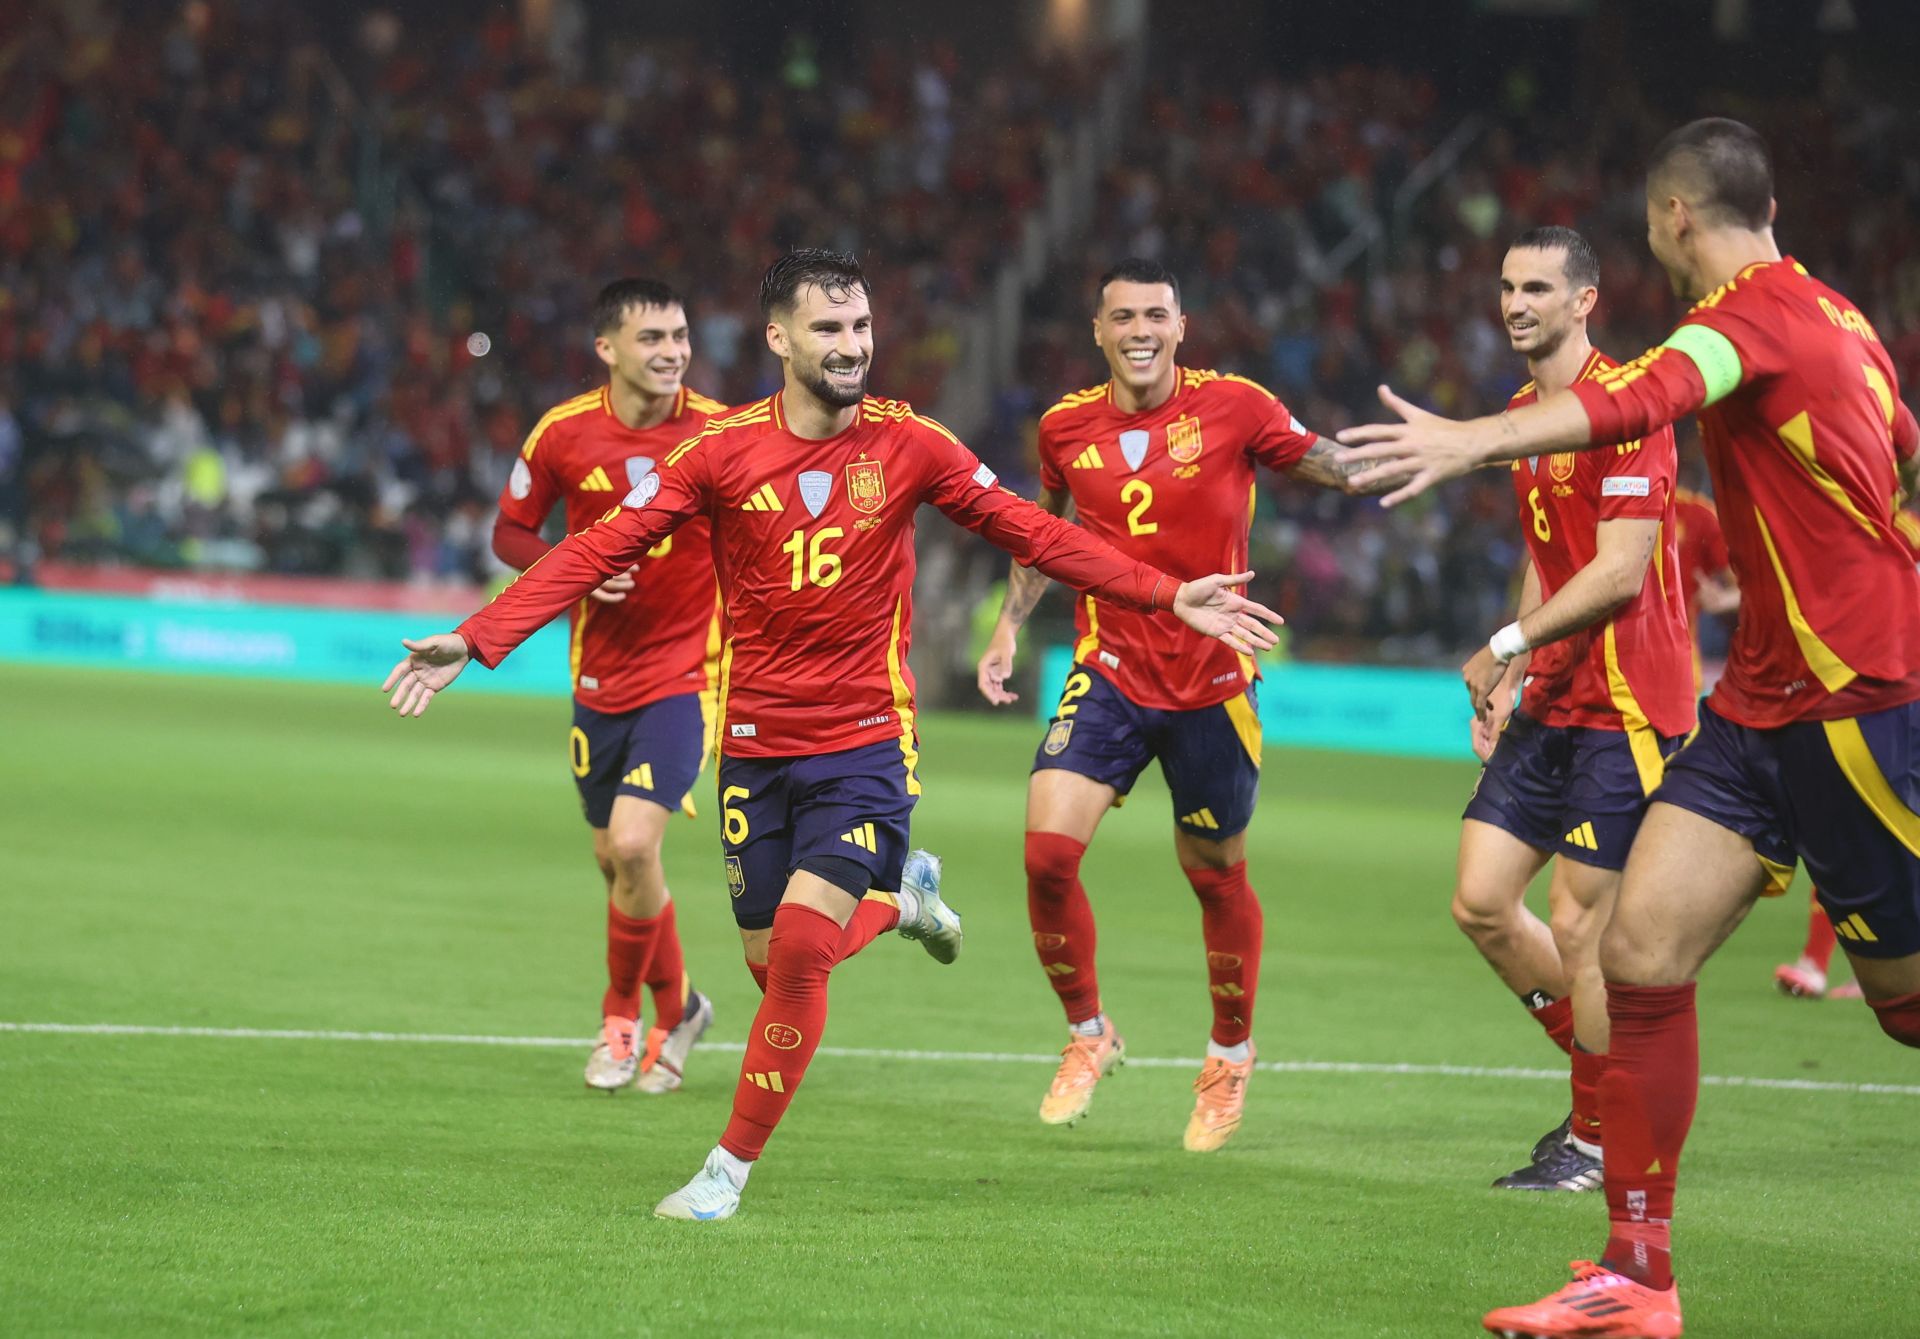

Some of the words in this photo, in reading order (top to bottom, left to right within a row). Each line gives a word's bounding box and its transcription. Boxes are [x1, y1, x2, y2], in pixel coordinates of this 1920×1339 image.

[1121, 479, 1158, 536] 2
[1528, 486, 1551, 543] 6
[783, 527, 844, 592] 16
[1056, 672, 1092, 719] 2
[722, 786, 750, 845] 6
